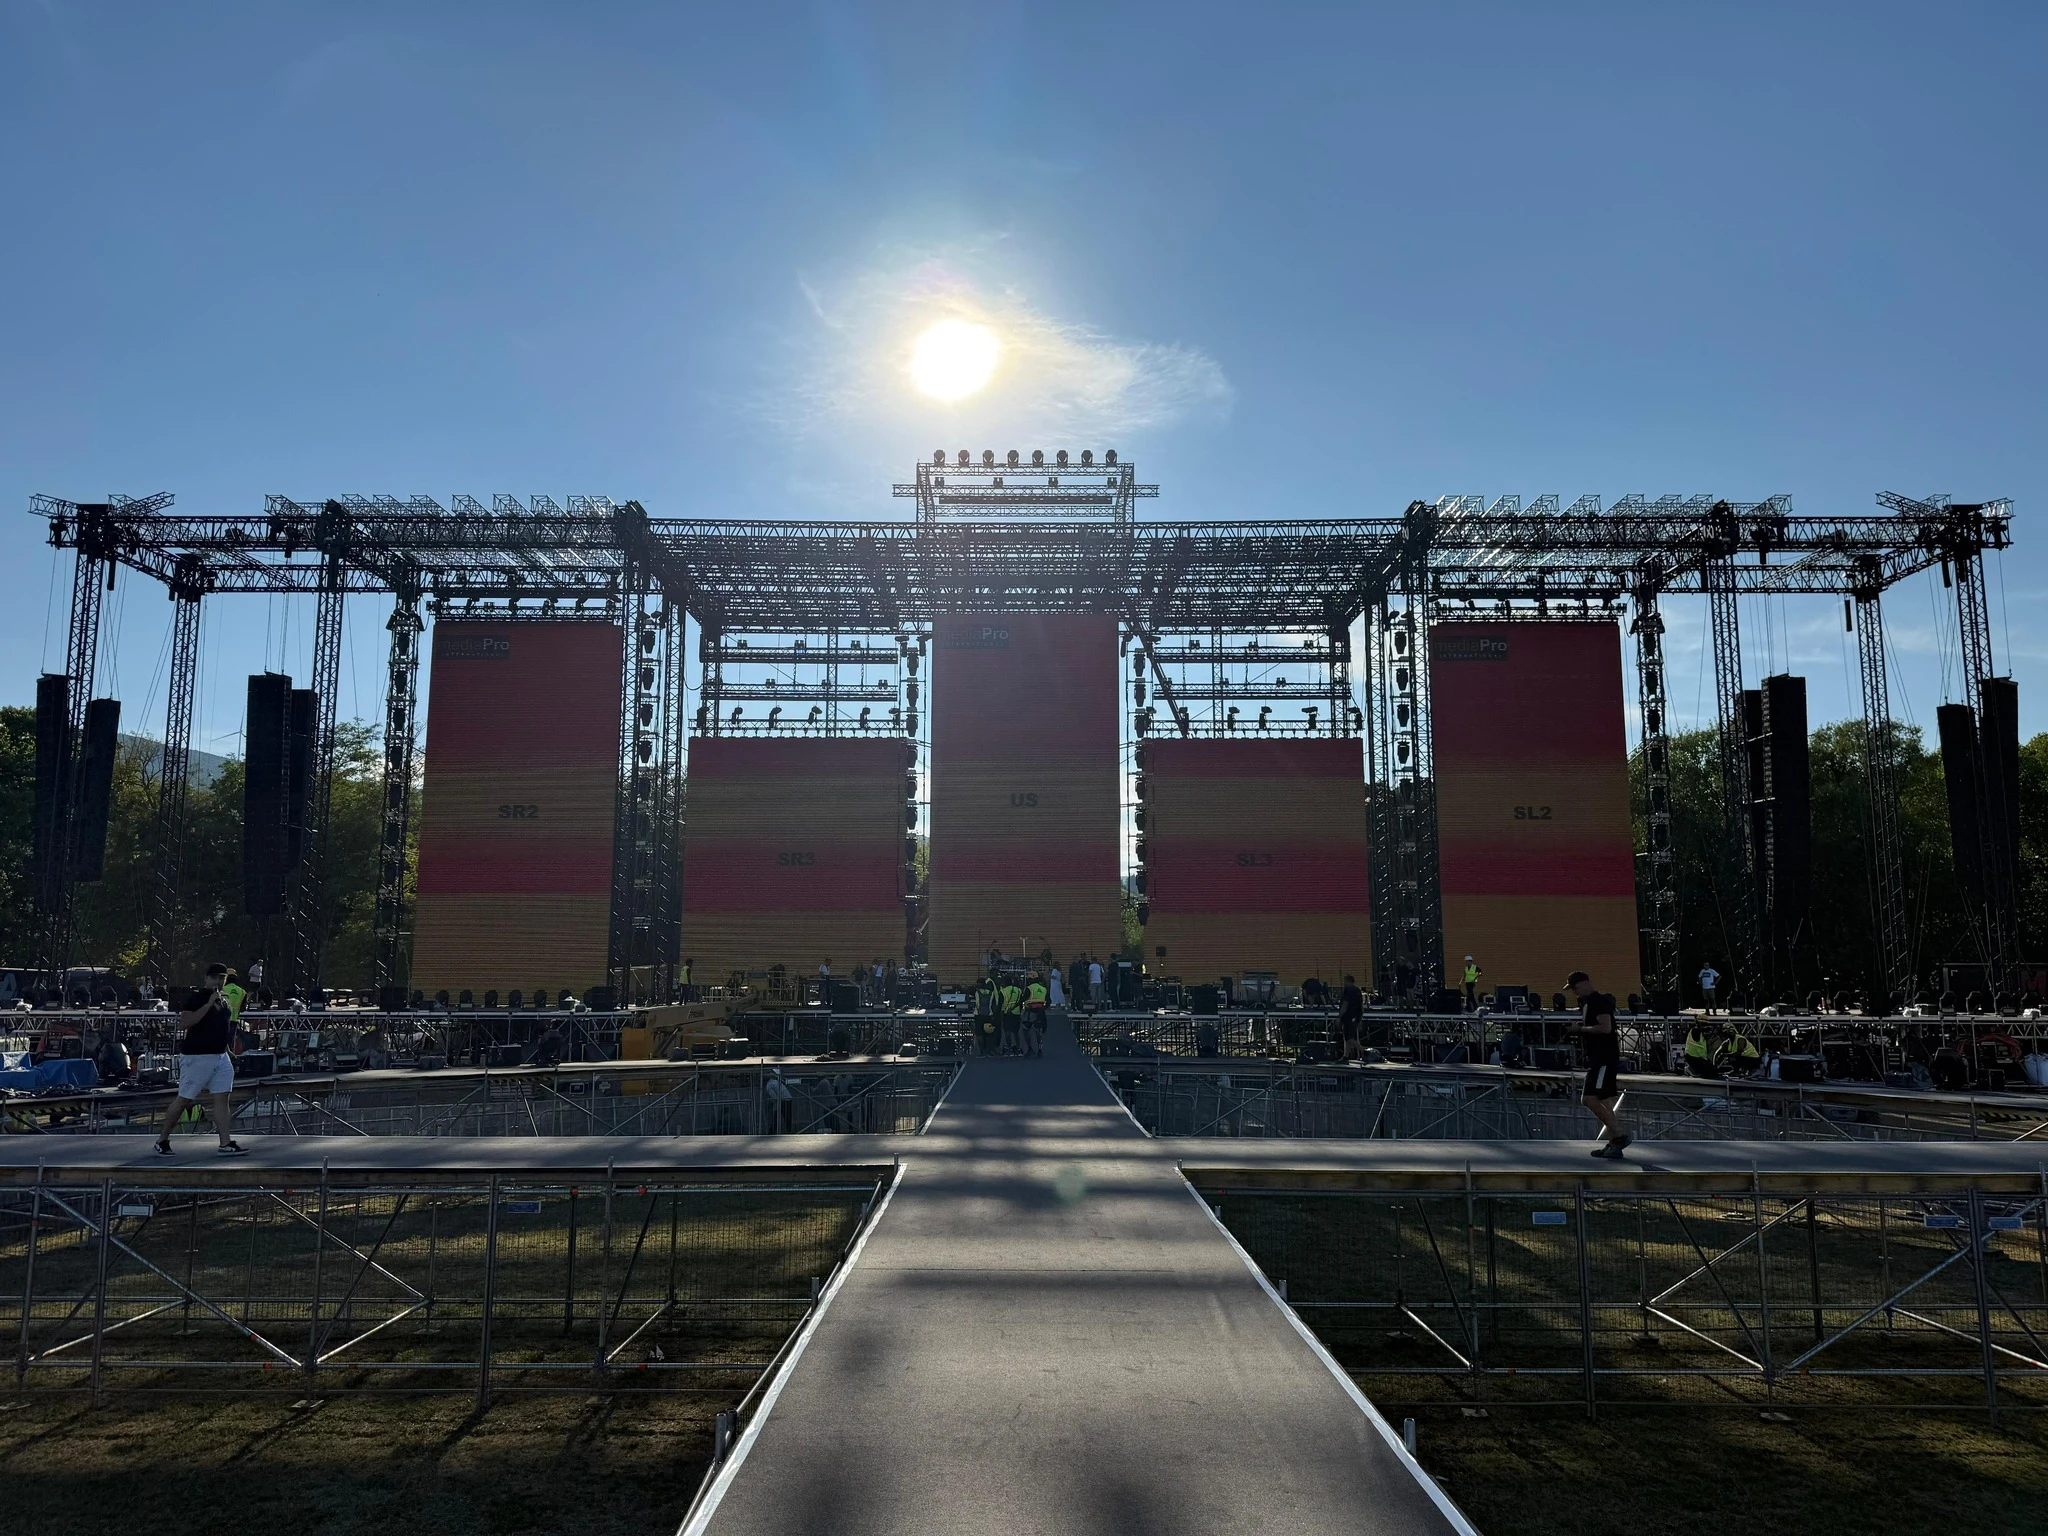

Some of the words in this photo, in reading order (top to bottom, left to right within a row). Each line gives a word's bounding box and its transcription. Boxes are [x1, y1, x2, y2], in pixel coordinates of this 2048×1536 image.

[1434, 639, 1508, 652] mediaPro
[1011, 791, 1038, 807] US
[498, 804, 538, 819] SR2
[1513, 805, 1552, 820] SL2
[778, 852, 816, 867] SR3
